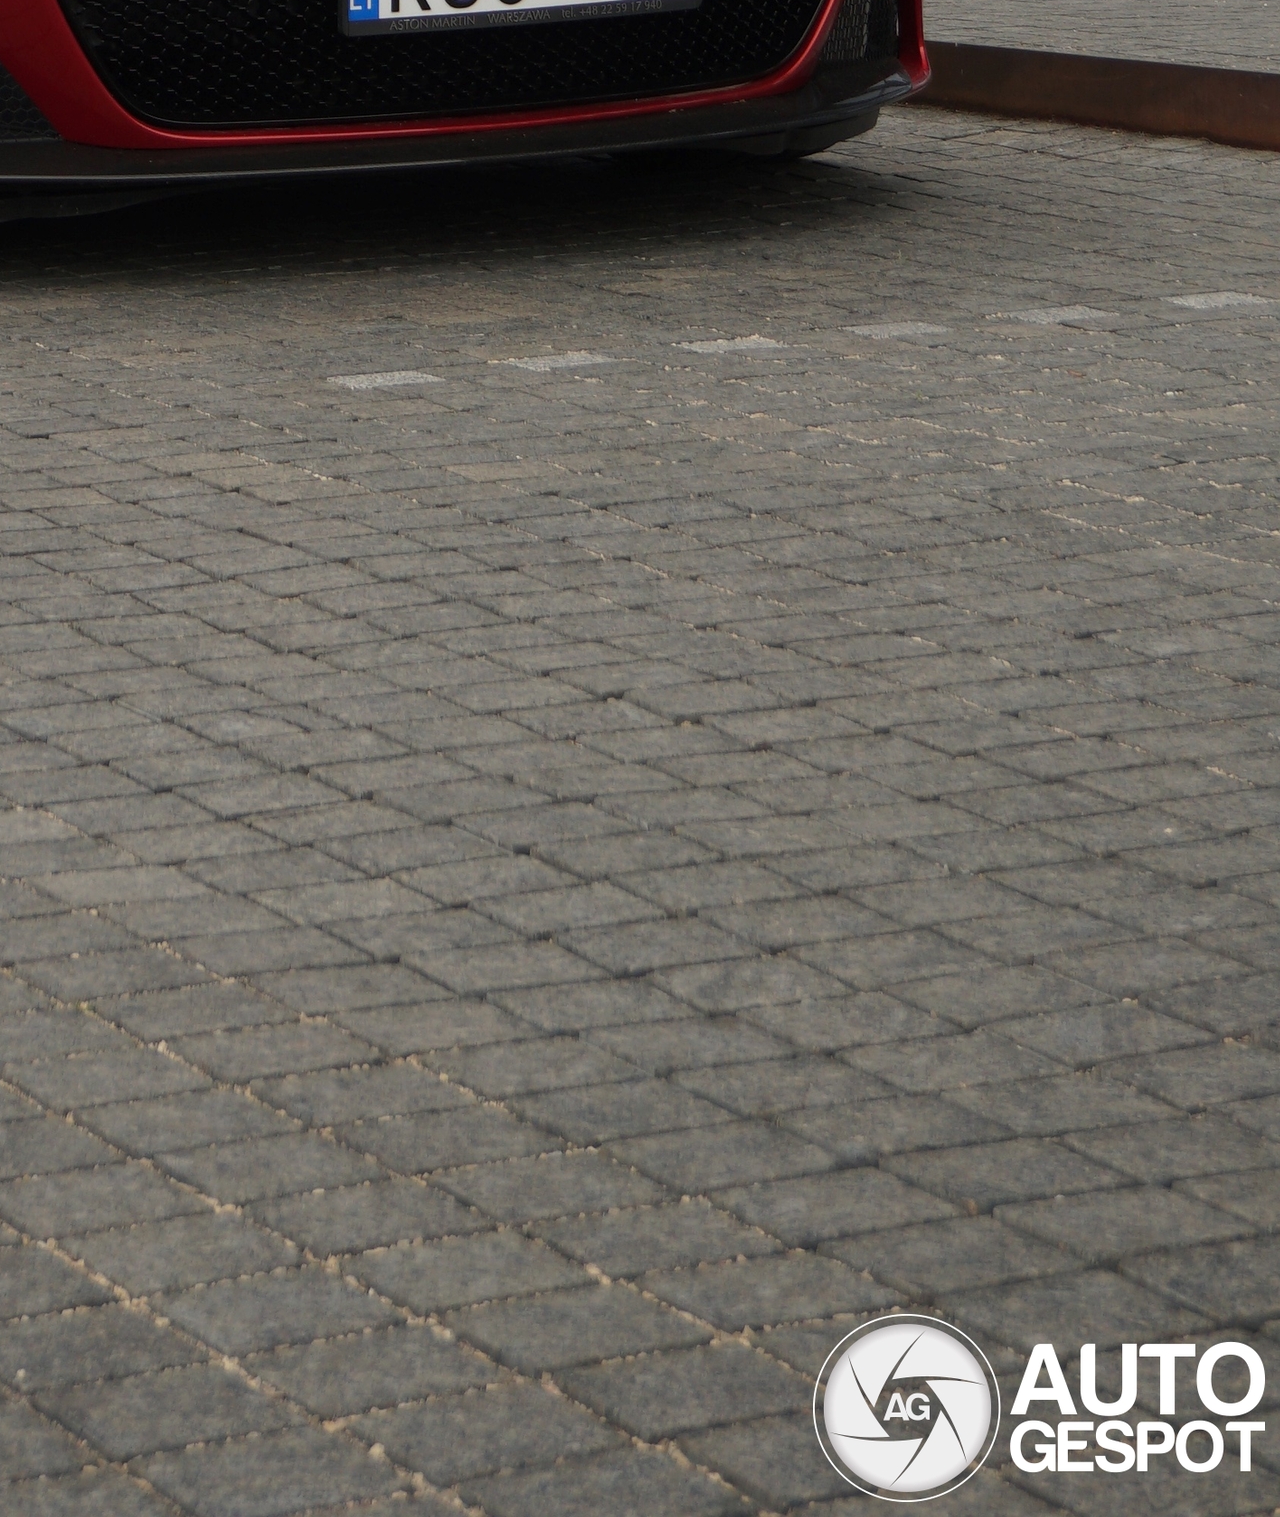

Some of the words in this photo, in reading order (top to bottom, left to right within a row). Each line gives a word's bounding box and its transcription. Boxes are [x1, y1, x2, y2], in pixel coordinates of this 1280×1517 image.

[389, 18, 428, 31] ASTON
[432, 16, 476, 29] MARTIN
[487, 9, 551, 24] WARSZAWA
[561, 8, 576, 19] tel.
[579, 5, 598, 16] +48
[601, 3, 613, 15] 22
